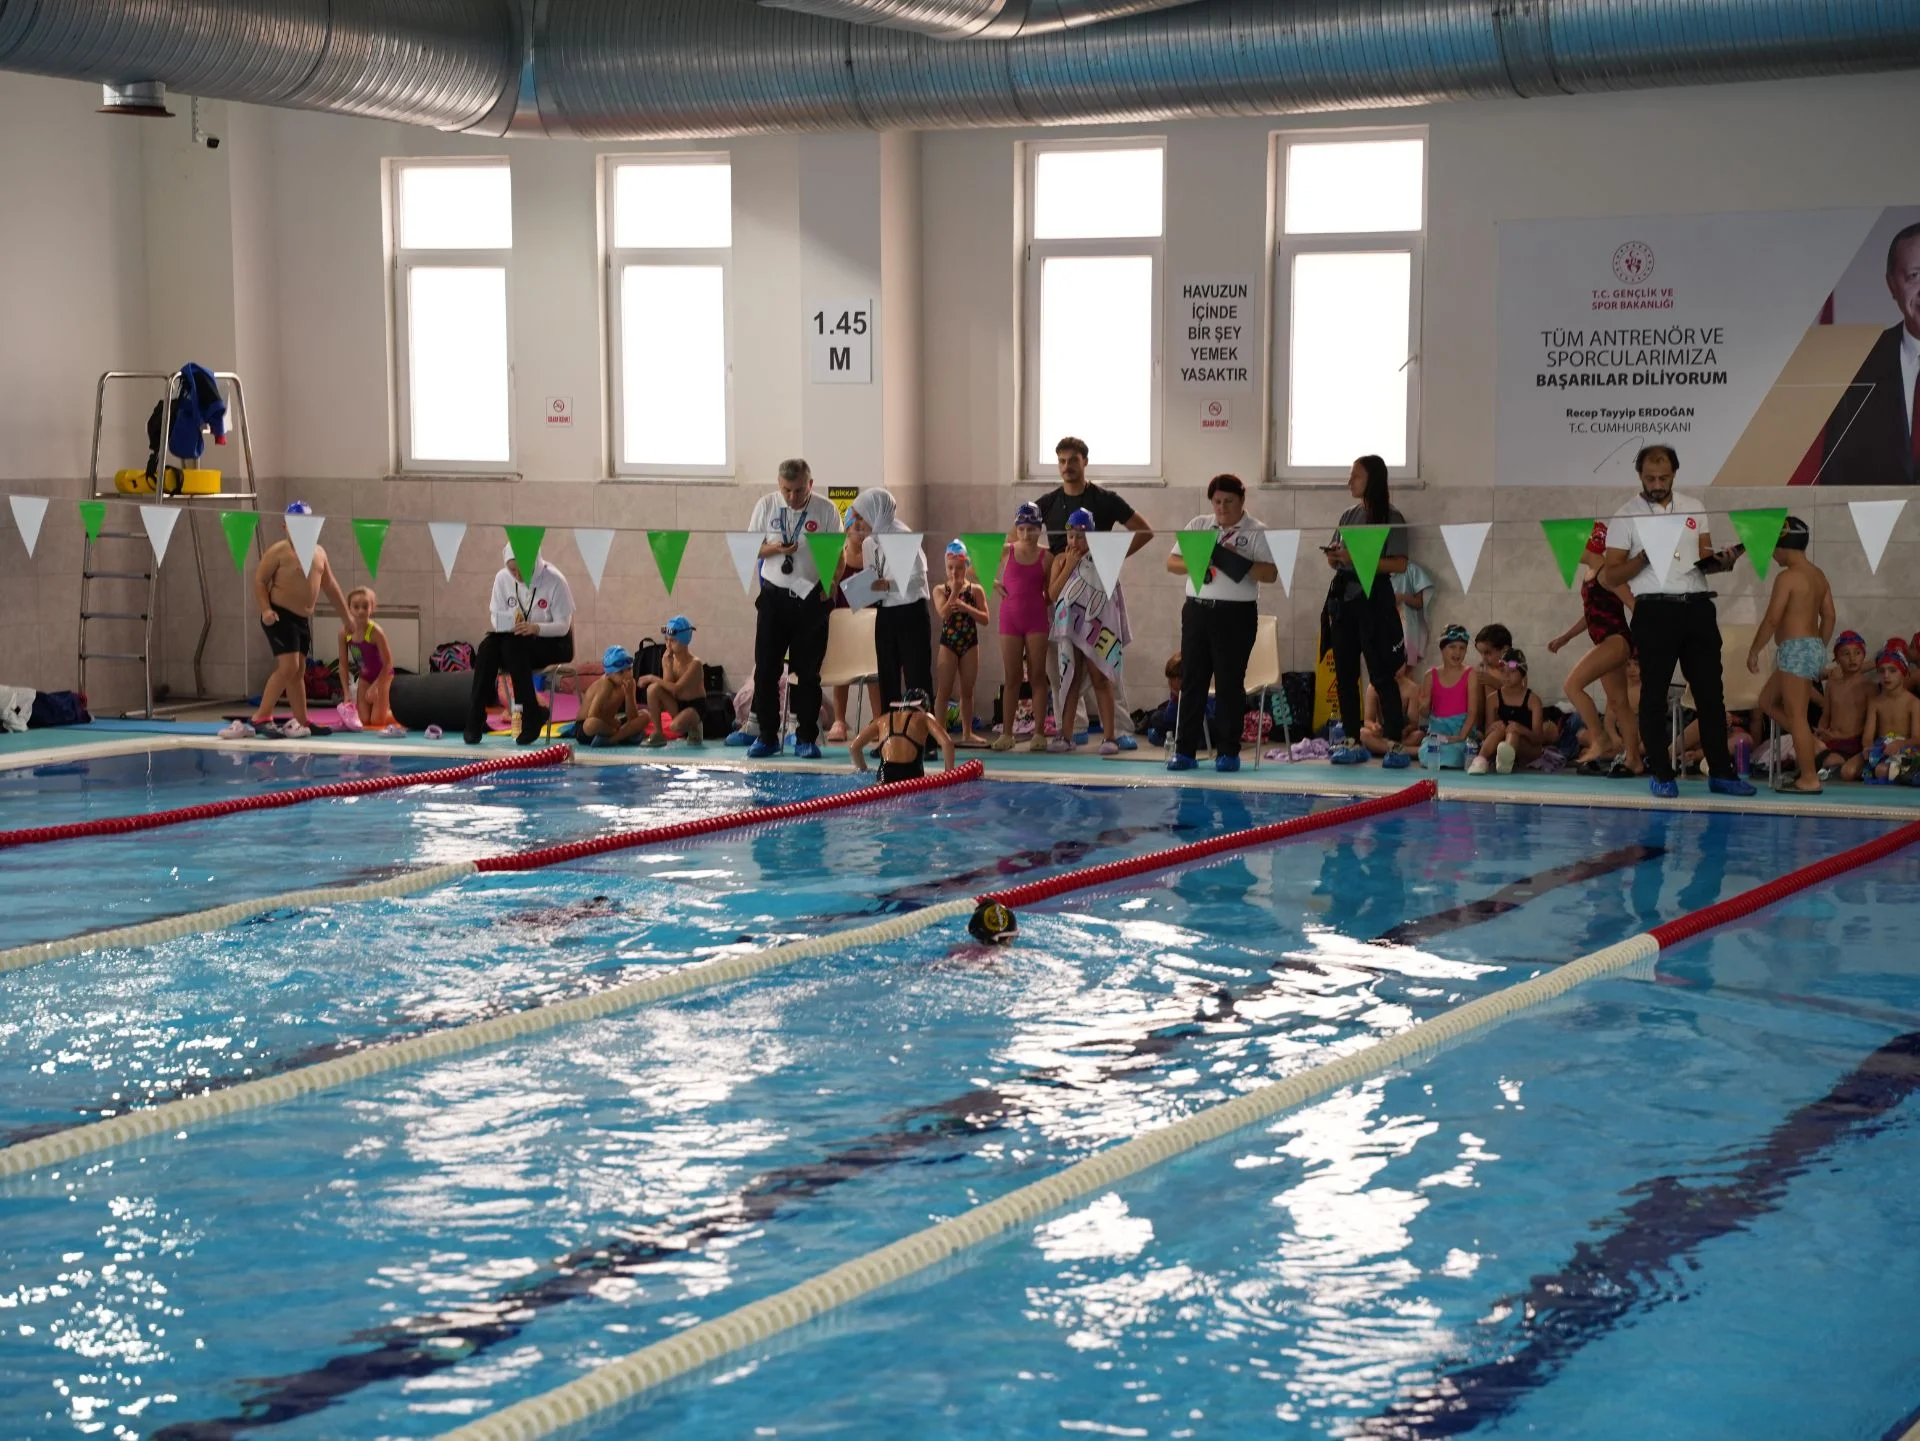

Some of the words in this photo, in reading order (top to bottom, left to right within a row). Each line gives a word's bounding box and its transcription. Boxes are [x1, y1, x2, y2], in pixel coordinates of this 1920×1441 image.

[1183, 284, 1248, 299] HAVUZUN
[1592, 289, 1610, 299] T.C.
[1613, 288, 1657, 300] GENÇLİK
[1661, 288, 1674, 298] VE
[1192, 302, 1238, 322] İÇİNDE
[1592, 301, 1618, 311] SPOR
[1620, 299, 1674, 310] BAKANLIĞI
[813, 310, 868, 336] 1.45
[1188, 324, 1211, 340] BİR
[1215, 325, 1242, 343] ŞEY
[1541, 327, 1584, 348] TÜM
[1589, 324, 1696, 347] ANTRENÖR
[1700, 327, 1724, 345] VE
[829, 347, 851, 371] M
[1190, 347, 1238, 361] YEMEK
[1546, 348, 1717, 368] SPORCULARIMIZA
[1181, 367, 1248, 381] YASAKTIR
[1536, 372, 1628, 390] BAŞARILAR
[1632, 369, 1727, 386] DİLİYORUM
[1566, 408, 1598, 419] Recep
[1600, 407, 1636, 419] Tayyip
[1638, 405, 1695, 417] ERDOĞAN
[1569, 423, 1588, 433] T.C.
[1590, 422, 1691, 435] CUMHURBAŞKANI
